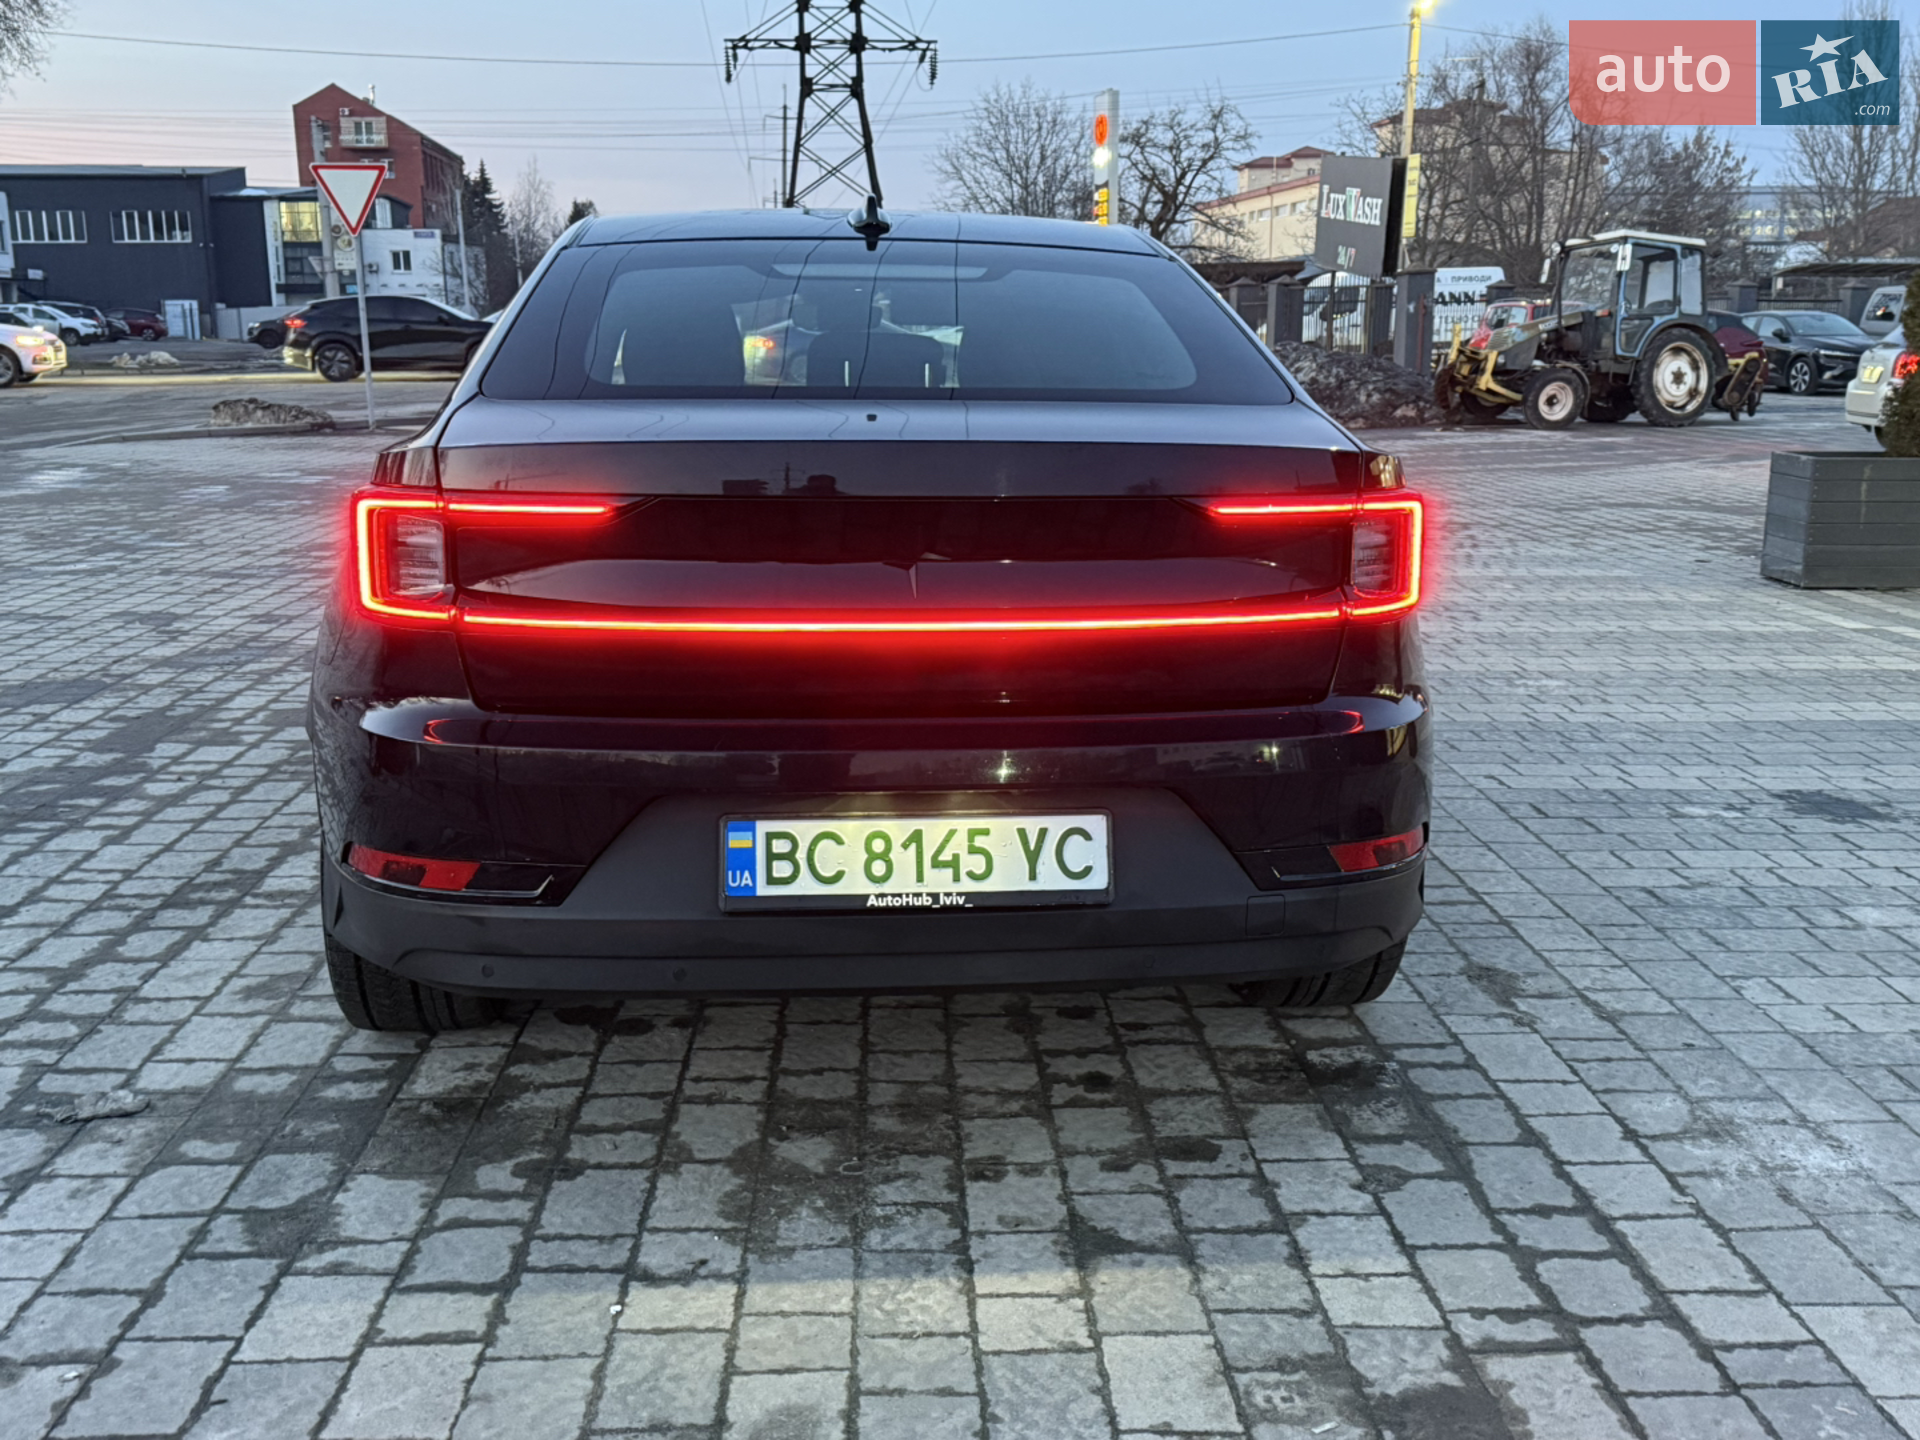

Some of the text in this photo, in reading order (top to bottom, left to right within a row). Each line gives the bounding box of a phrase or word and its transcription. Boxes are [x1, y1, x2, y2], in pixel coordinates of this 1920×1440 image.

[1451, 275, 1492, 283] ПРИВОДИ
[765, 826, 1094, 886] BC 8145 YC
[728, 870, 753, 888] UA
